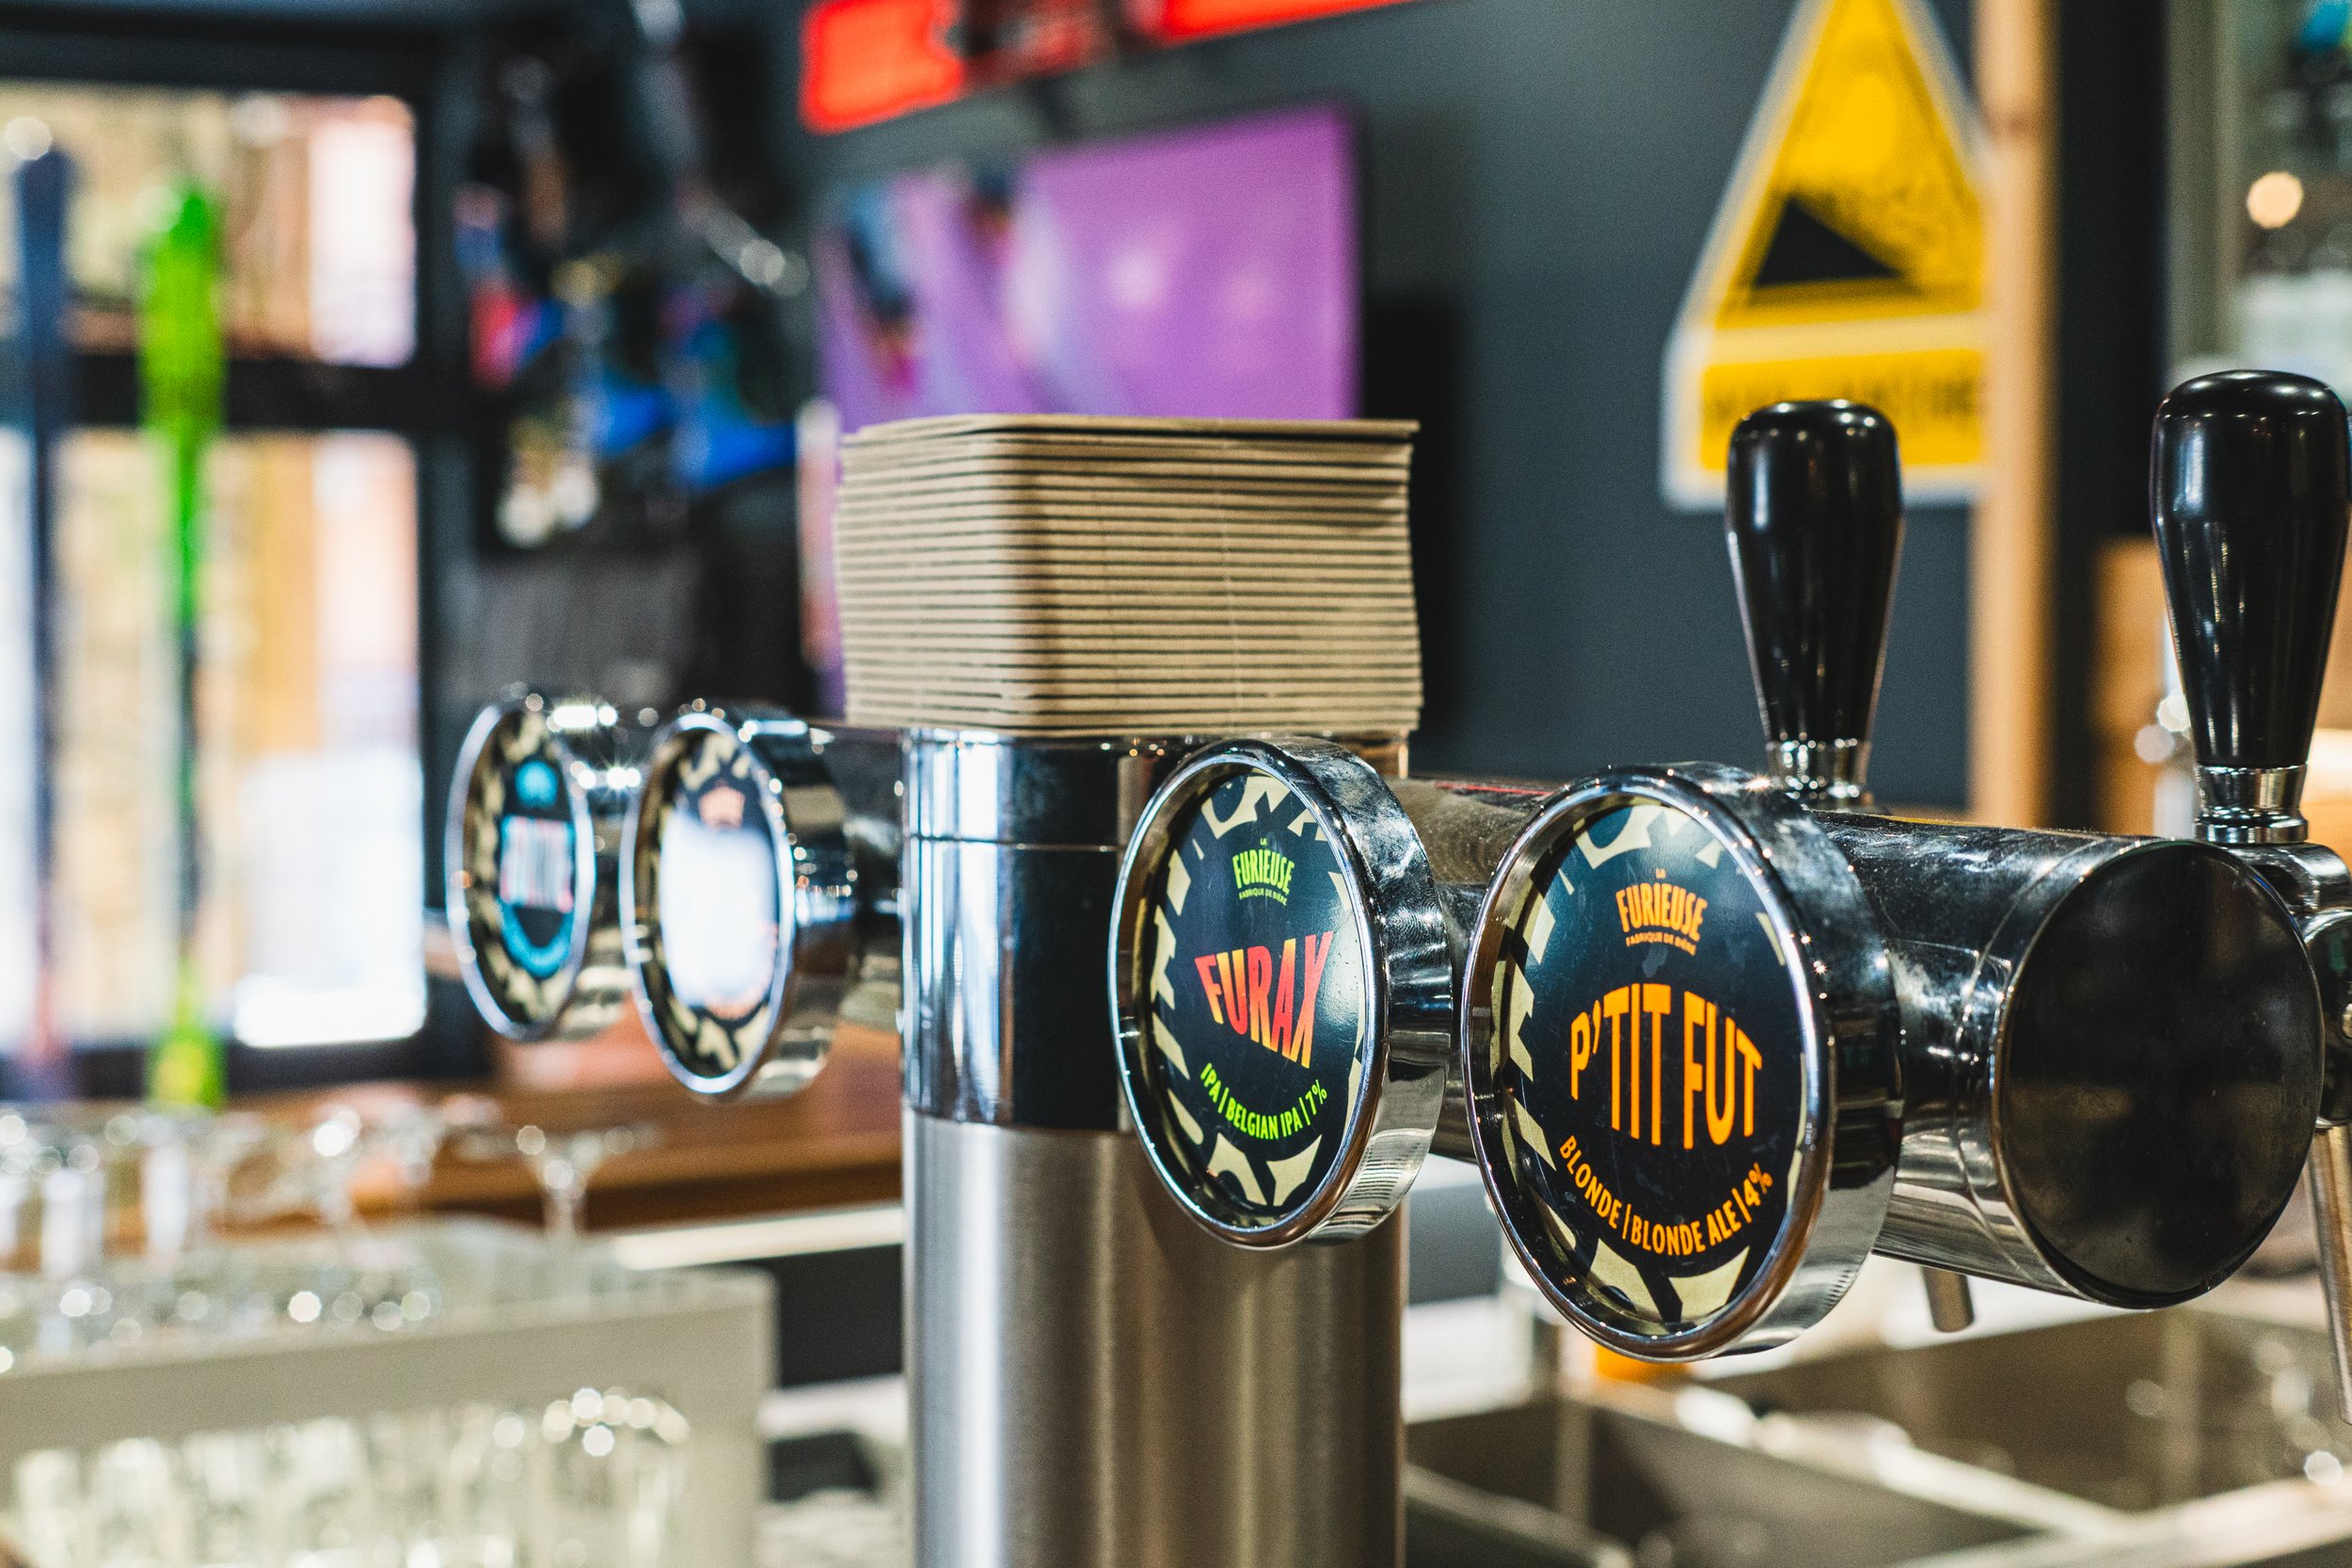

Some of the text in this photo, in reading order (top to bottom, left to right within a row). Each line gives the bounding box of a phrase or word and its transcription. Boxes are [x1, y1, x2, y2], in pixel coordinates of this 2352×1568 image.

[1232, 849, 1295, 895] FURIEUSE
[1239, 888, 1264, 900] FABRIQUE
[1264, 889, 1273, 898] DE
[1615, 882, 1708, 942] FURIEUSE
[1662, 933, 1675, 945] DE
[1195, 931, 1333, 1069] FURAX
[1200, 1062, 1222, 1103] IPA
[1225, 1097, 1279, 1140] BELGIAN
[1280, 1106, 1304, 1137] IPA
[1305, 1079, 1328, 1116] 7%
[1683, 990, 1762, 1149] FUT
[1559, 1135, 1623, 1229] BLONDE
[1630, 1214, 1707, 1257] BLONDE
[1707, 1200, 1742, 1246] ALE
[1743, 1162, 1773, 1207] 4%
